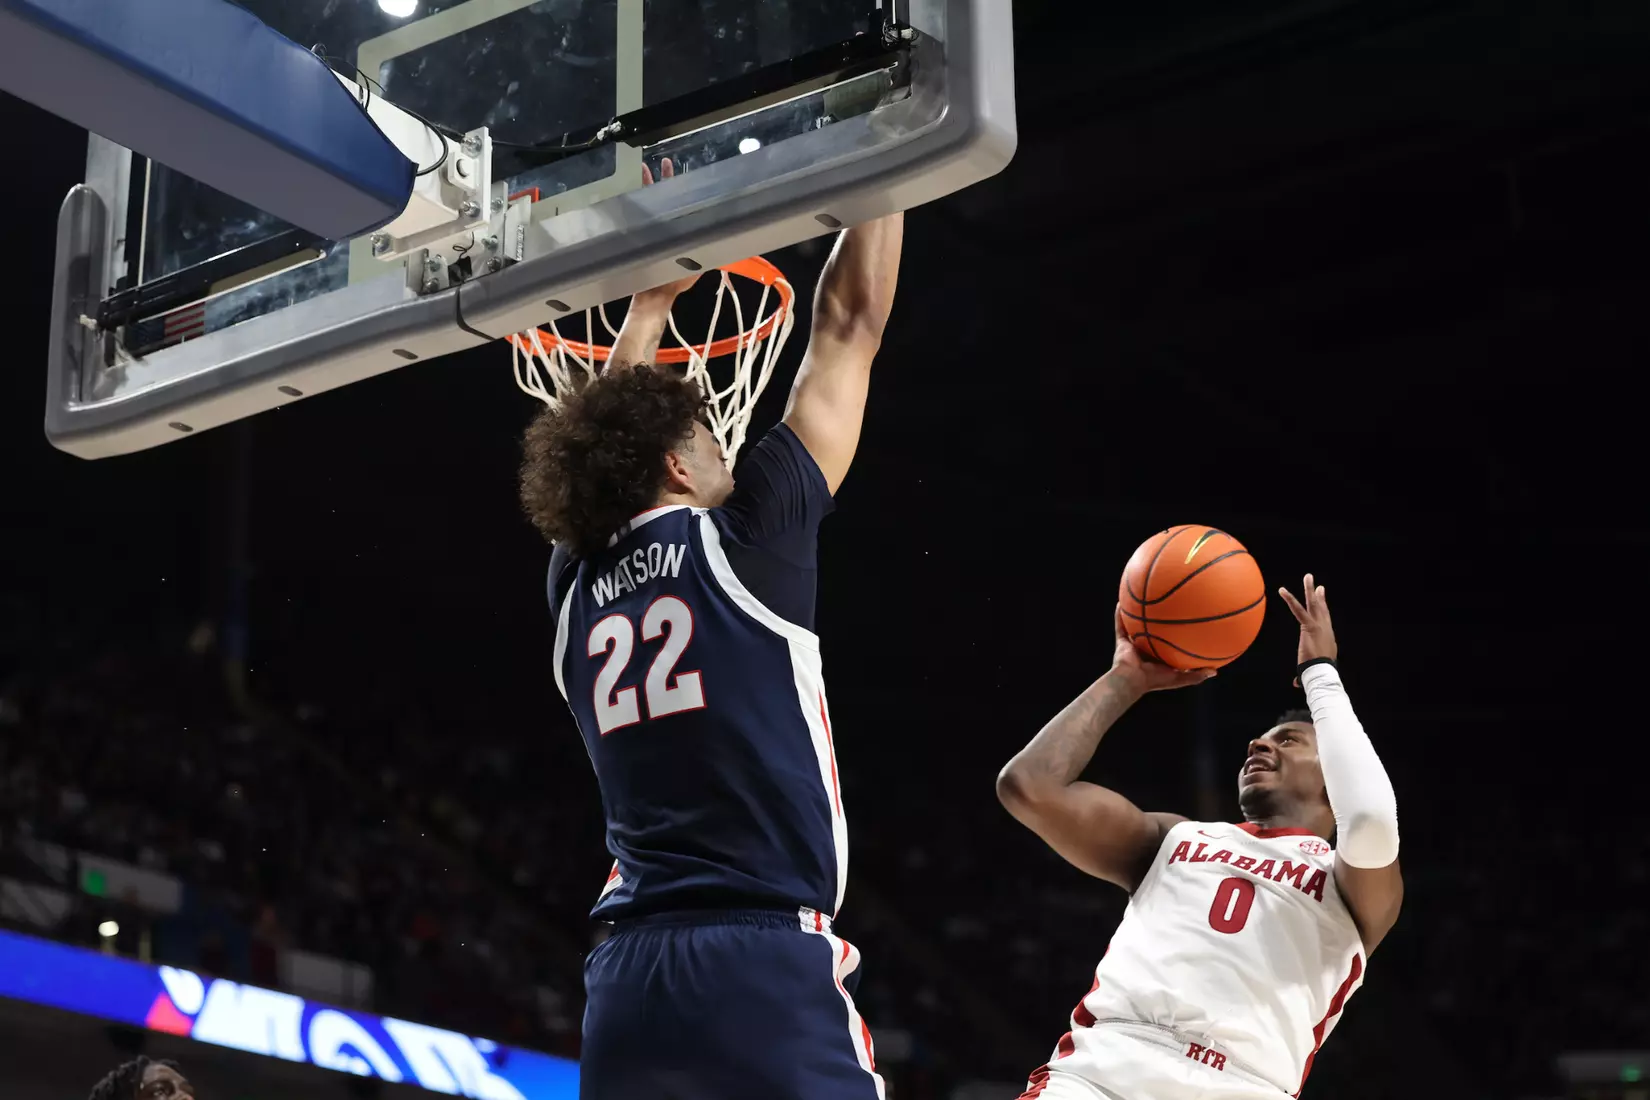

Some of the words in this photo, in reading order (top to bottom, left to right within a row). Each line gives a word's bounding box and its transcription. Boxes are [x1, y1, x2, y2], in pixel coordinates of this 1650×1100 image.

[592, 542, 687, 608] WATSON
[587, 594, 707, 736] 22
[1168, 840, 1328, 902] ALABAMA
[1300, 841, 1329, 856] SEC
[1208, 877, 1256, 934] 0
[1186, 1042, 1227, 1071] RTR
